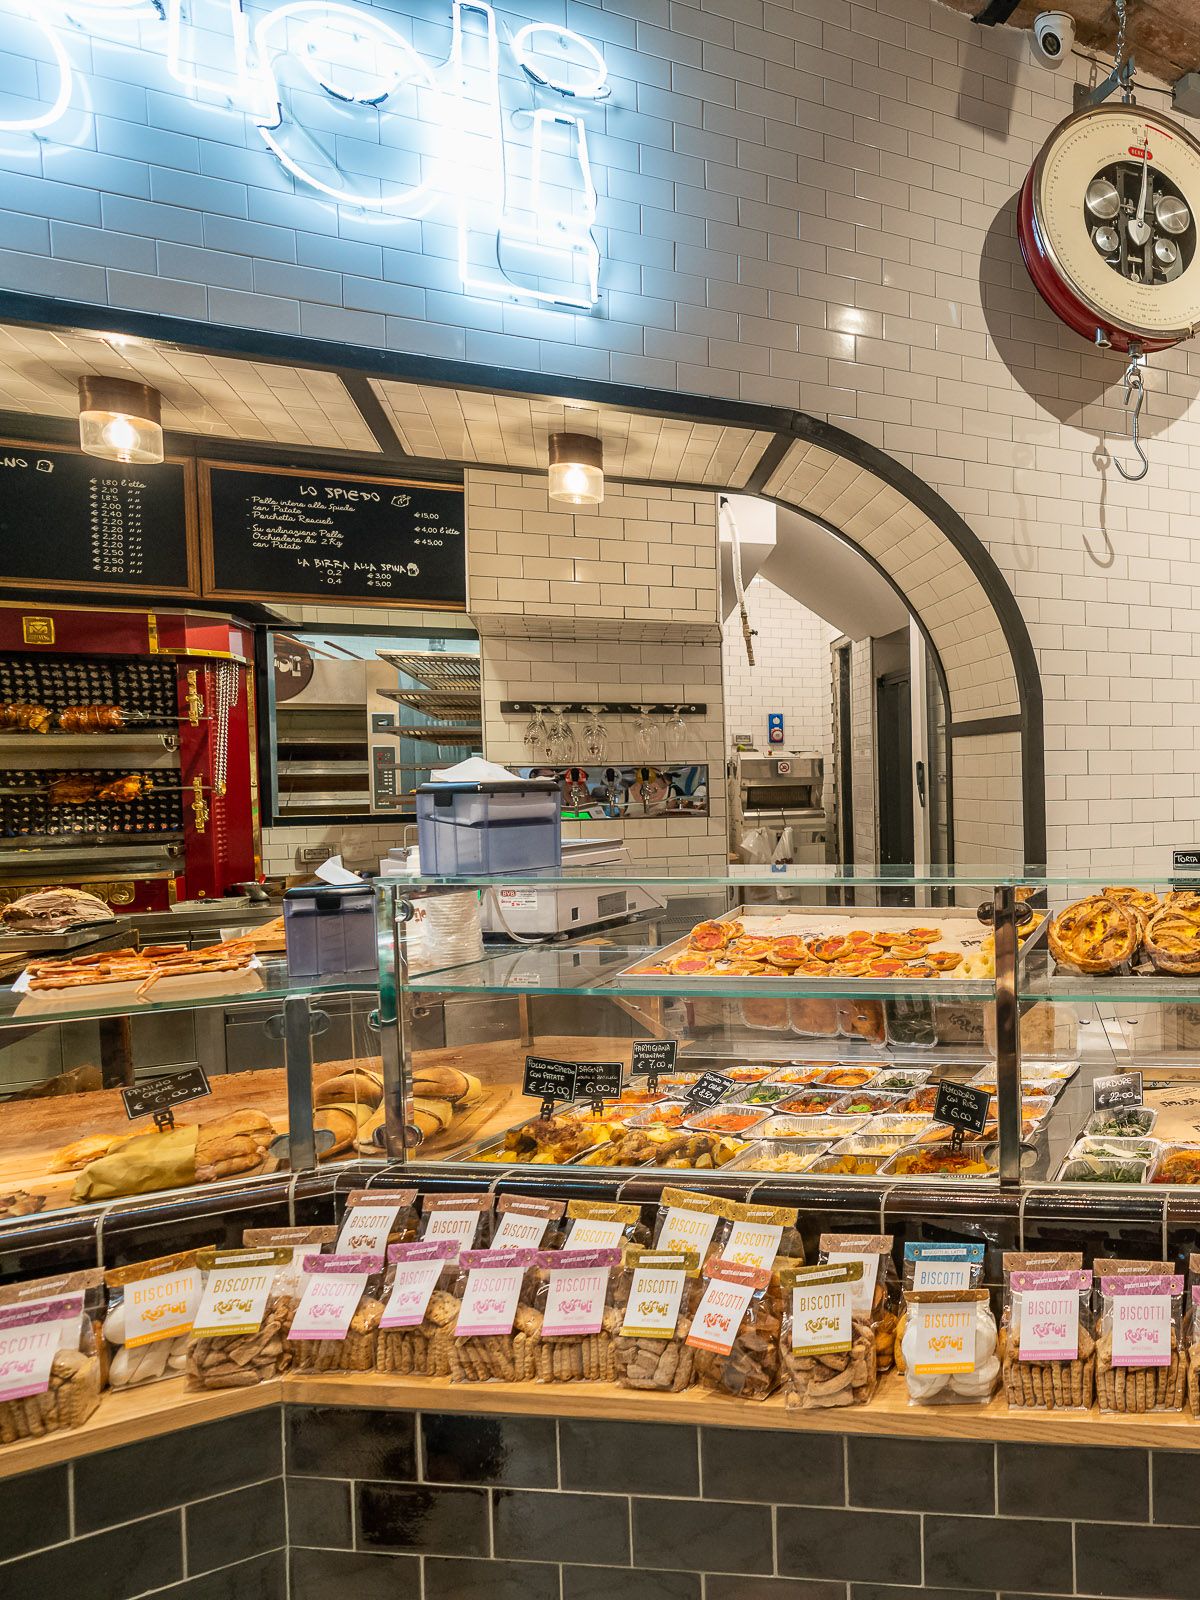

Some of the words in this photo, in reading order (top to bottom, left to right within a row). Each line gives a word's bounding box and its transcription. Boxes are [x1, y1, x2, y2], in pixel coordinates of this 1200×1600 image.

[300, 485, 318, 496] LO
[324, 487, 381, 502] SPIEDO
[297, 558, 310, 567] LA
[313, 558, 350, 570] BIRRA
[353, 562, 377, 571] ALLA
[380, 563, 407, 574] SPINA
[1174, 853, 1199, 863] TORTA
[528, 1060, 546, 1070] POLLO
[529, 1081, 537, 1093] €
[1096, 1076, 1132, 1091] VERDURE
[574, 1228, 616, 1245] BISCOTTI
[735, 1231, 775, 1247] BISCOTTI
[213, 1275, 267, 1294] BISCOTTI
[471, 1277, 516, 1293] BISCOTTI
[555, 1276, 601, 1293] BISCOTTI
[920, 1270, 964, 1286] BISCOTTI
[133, 1276, 194, 1304] BISCOTTI
[310, 1282, 360, 1298] BISCOTTI
[636, 1279, 678, 1295] BISCOTTI
[706, 1292, 745, 1311] BISCOTTI
[799, 1292, 846, 1312] BISCOTTI
[1028, 1299, 1073, 1316] BISCOTTI
[923, 1311, 971, 1329] BISCOTTI
[1120, 1305, 1166, 1322] BISCOTTI
